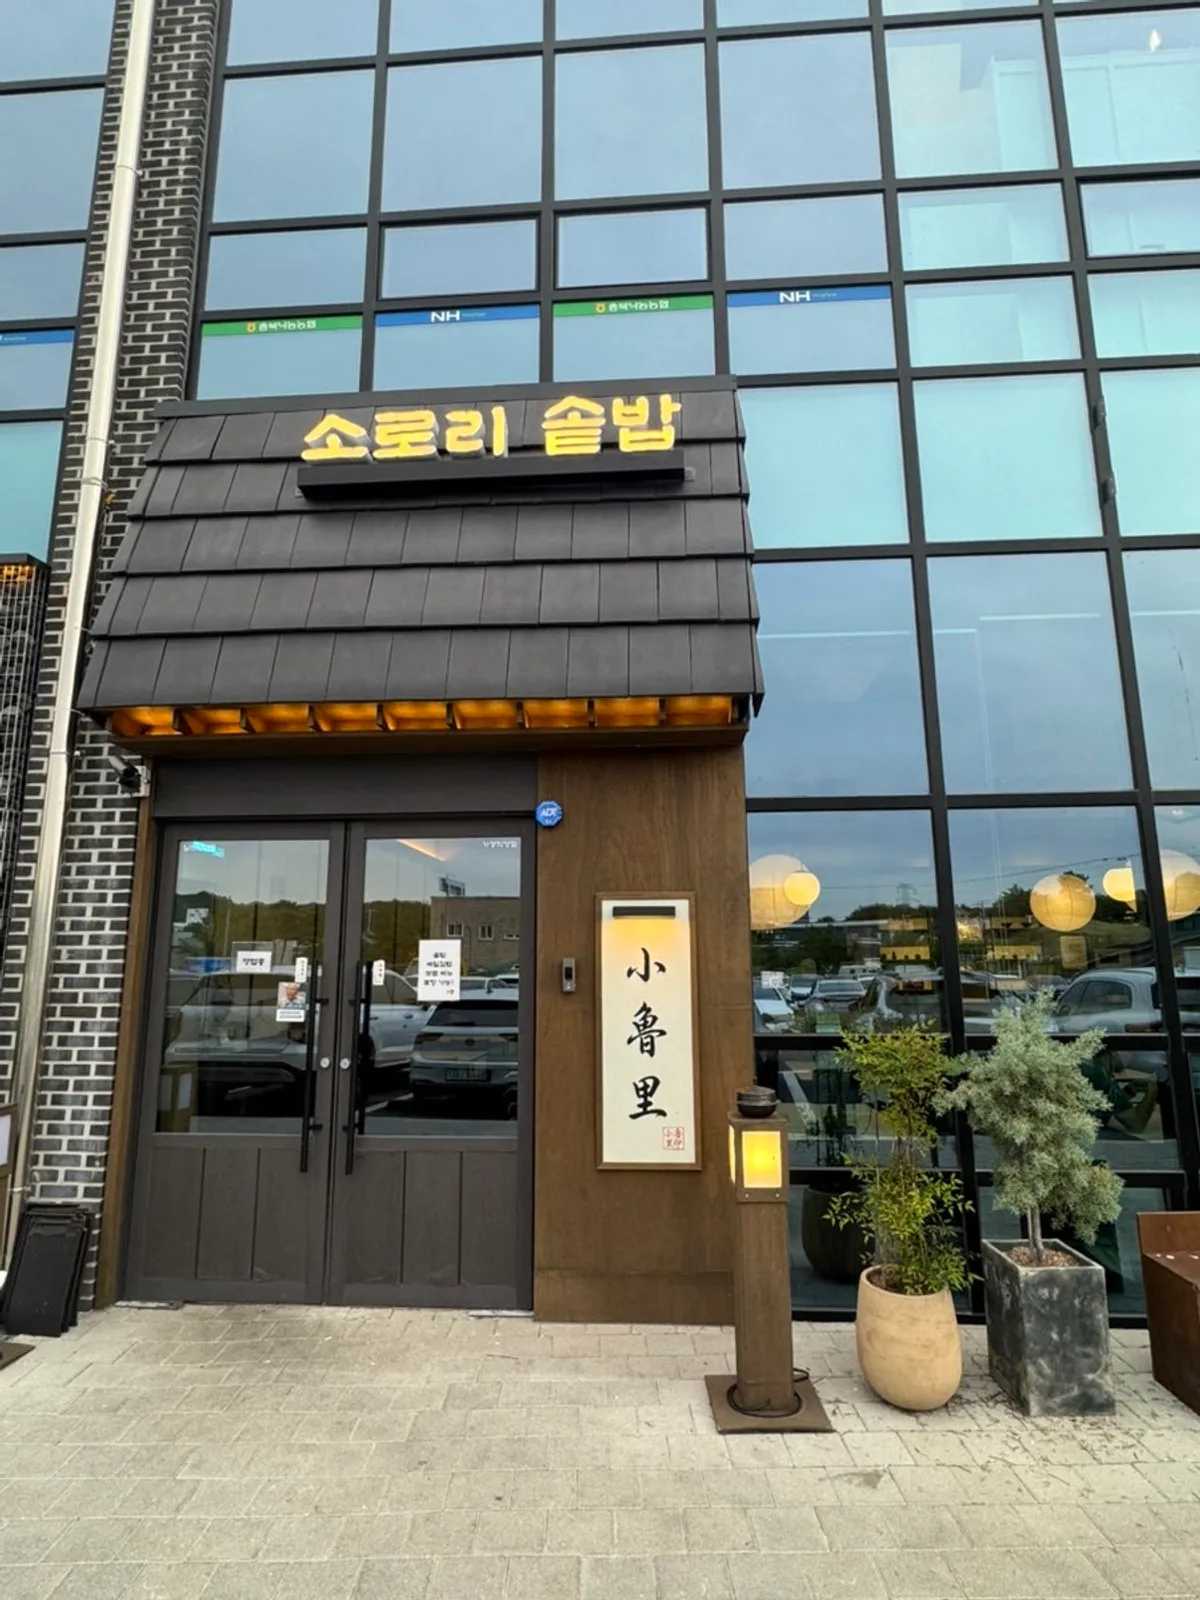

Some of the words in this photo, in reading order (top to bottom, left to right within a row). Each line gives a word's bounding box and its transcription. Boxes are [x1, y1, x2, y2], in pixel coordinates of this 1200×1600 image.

[779, 290, 811, 303] NH
[430, 310, 461, 323] NH
[301, 405, 506, 461] 소로리
[541, 393, 682, 457] 솥밥
